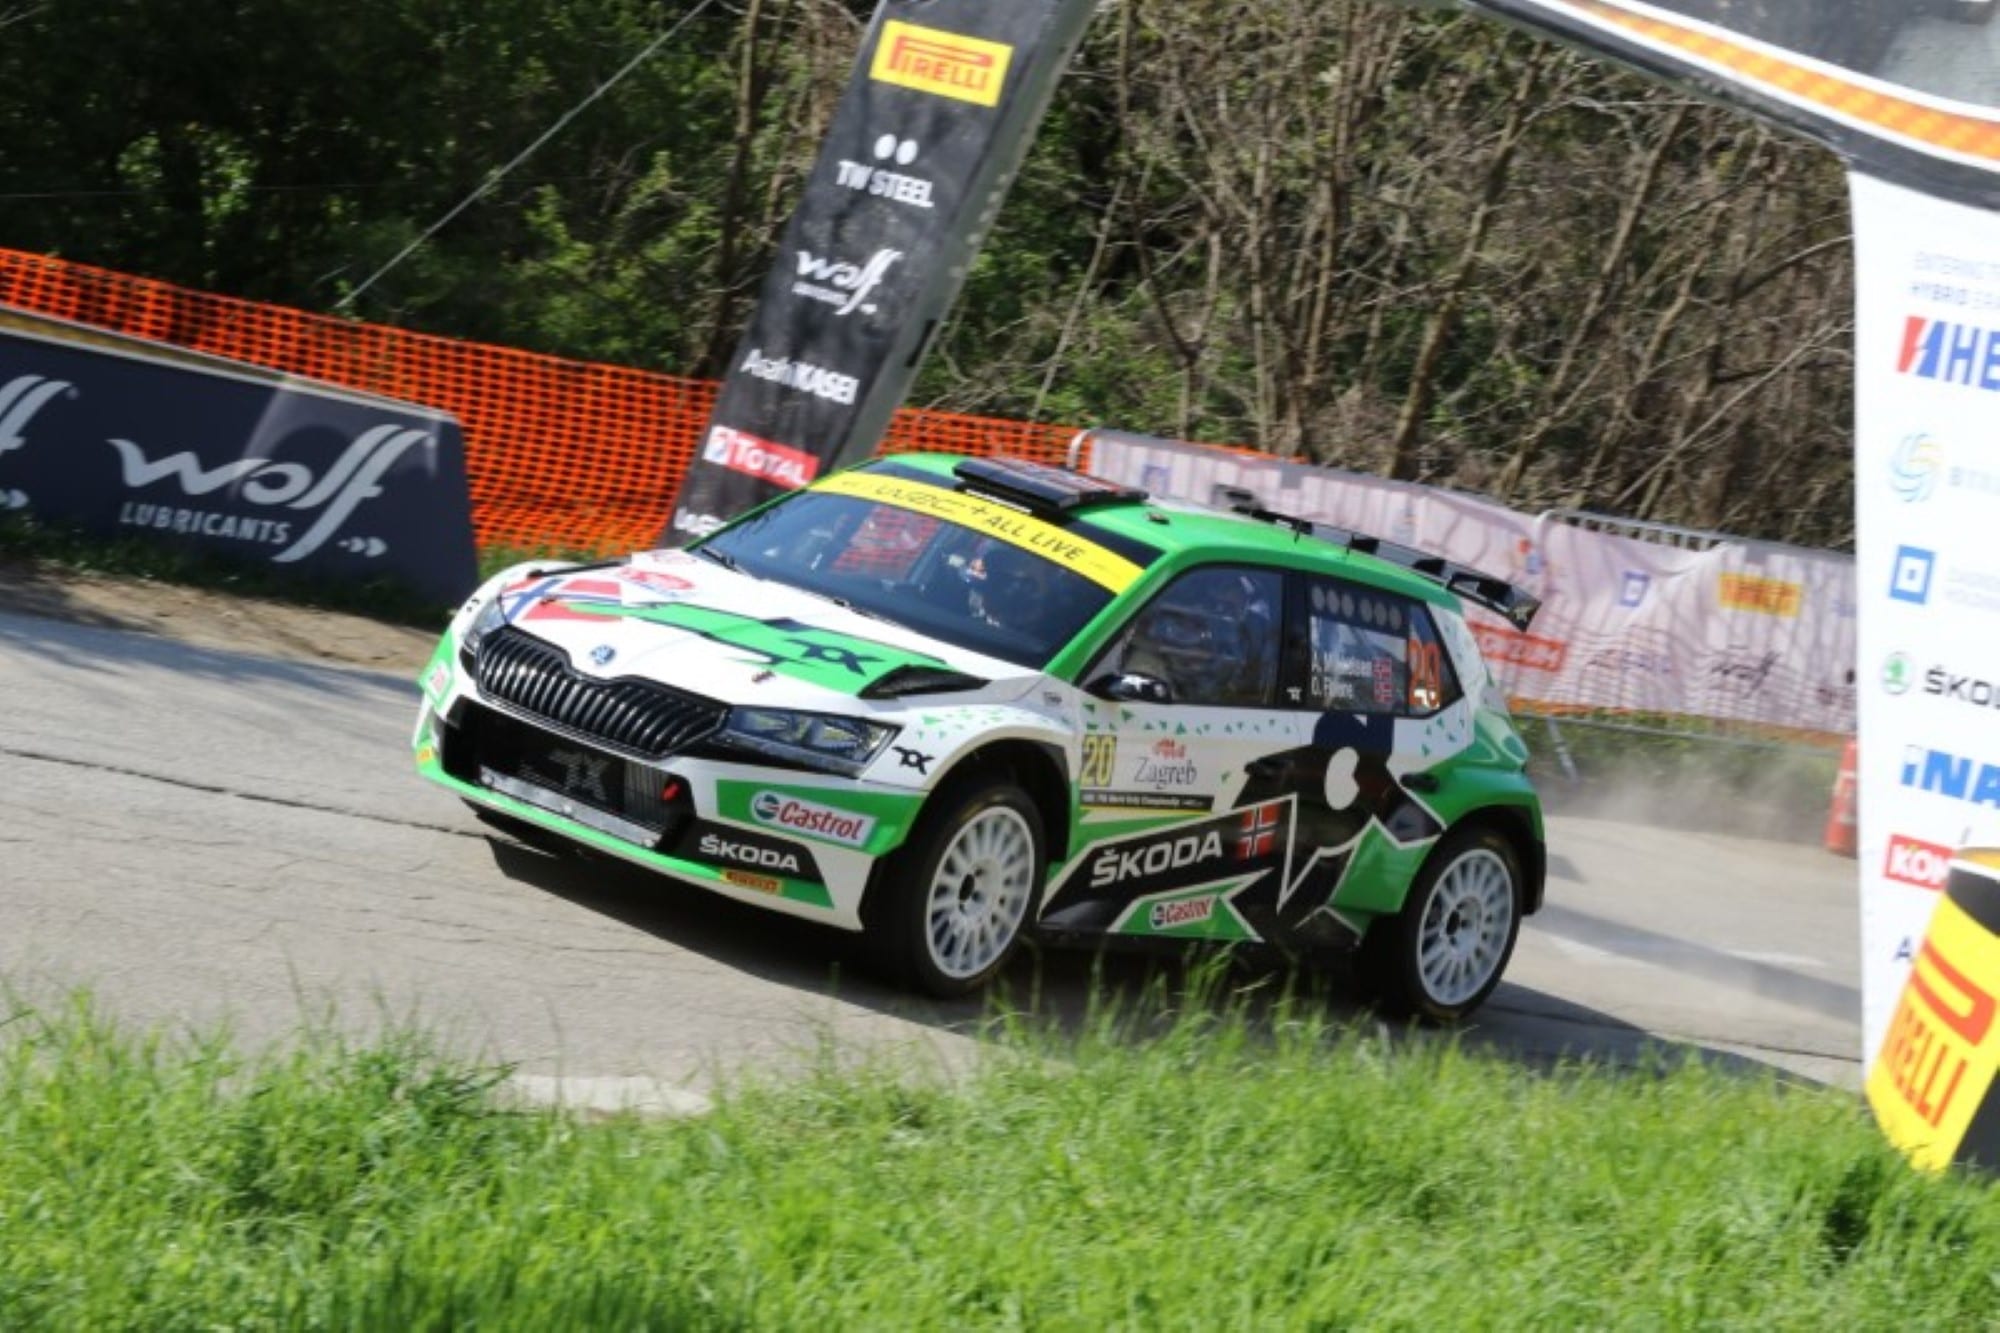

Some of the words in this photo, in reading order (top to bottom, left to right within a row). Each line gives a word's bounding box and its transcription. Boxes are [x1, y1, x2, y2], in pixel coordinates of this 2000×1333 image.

[888, 36, 996, 92] PIRELLI
[868, 169, 934, 207] STEEL
[120, 500, 293, 545] LUBRICANTS
[984, 515, 1024, 538] ALL
[1029, 530, 1086, 562] LIVE
[1080, 734, 1116, 788] 20
[1133, 756, 1198, 790] Zagreb
[779, 801, 865, 840] Castrol
[699, 833, 801, 873] ŠKODA
[1089, 830, 1223, 888] ŠKODA
